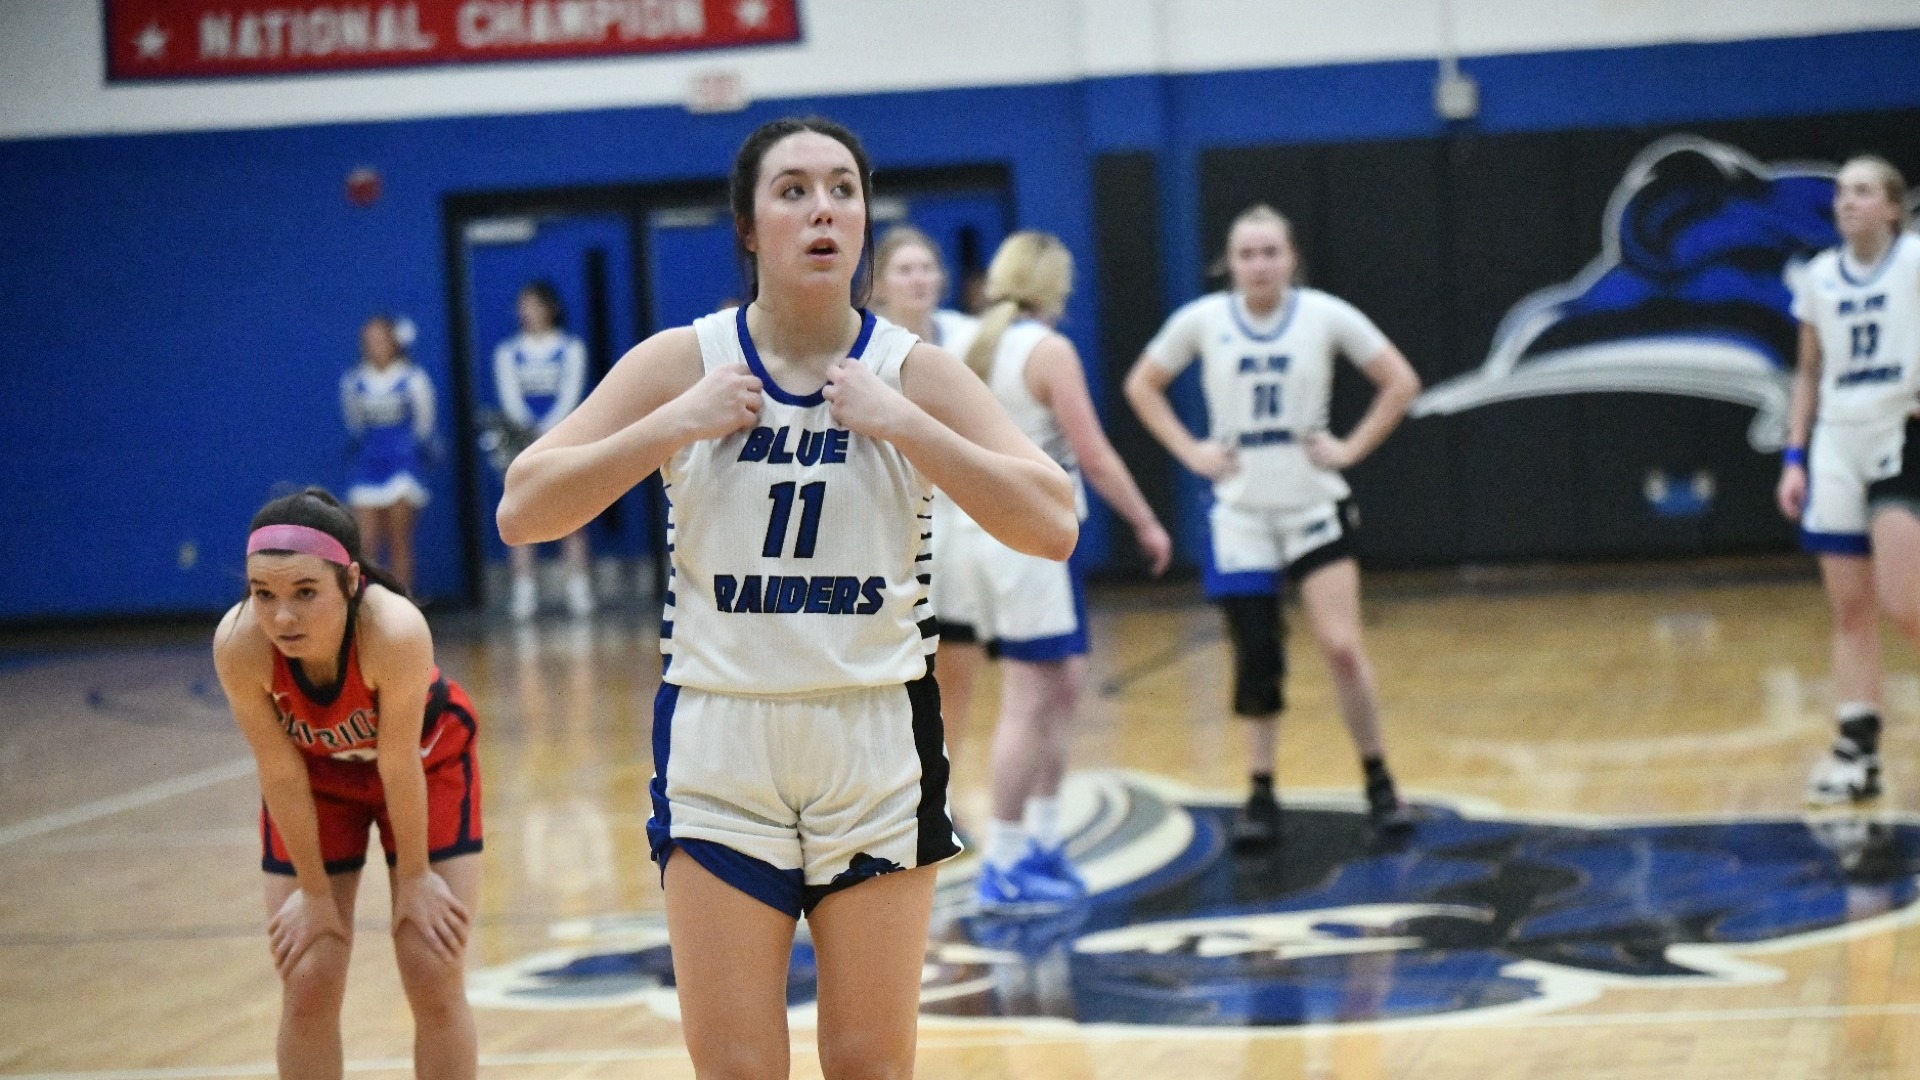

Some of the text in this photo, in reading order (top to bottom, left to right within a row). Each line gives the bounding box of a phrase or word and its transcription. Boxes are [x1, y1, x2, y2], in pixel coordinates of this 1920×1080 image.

[200, 2, 437, 58] NATIONAL
[737, 425, 850, 466] BLUE
[762, 481, 826, 558] 11
[714, 574, 887, 614] RAIDERS
